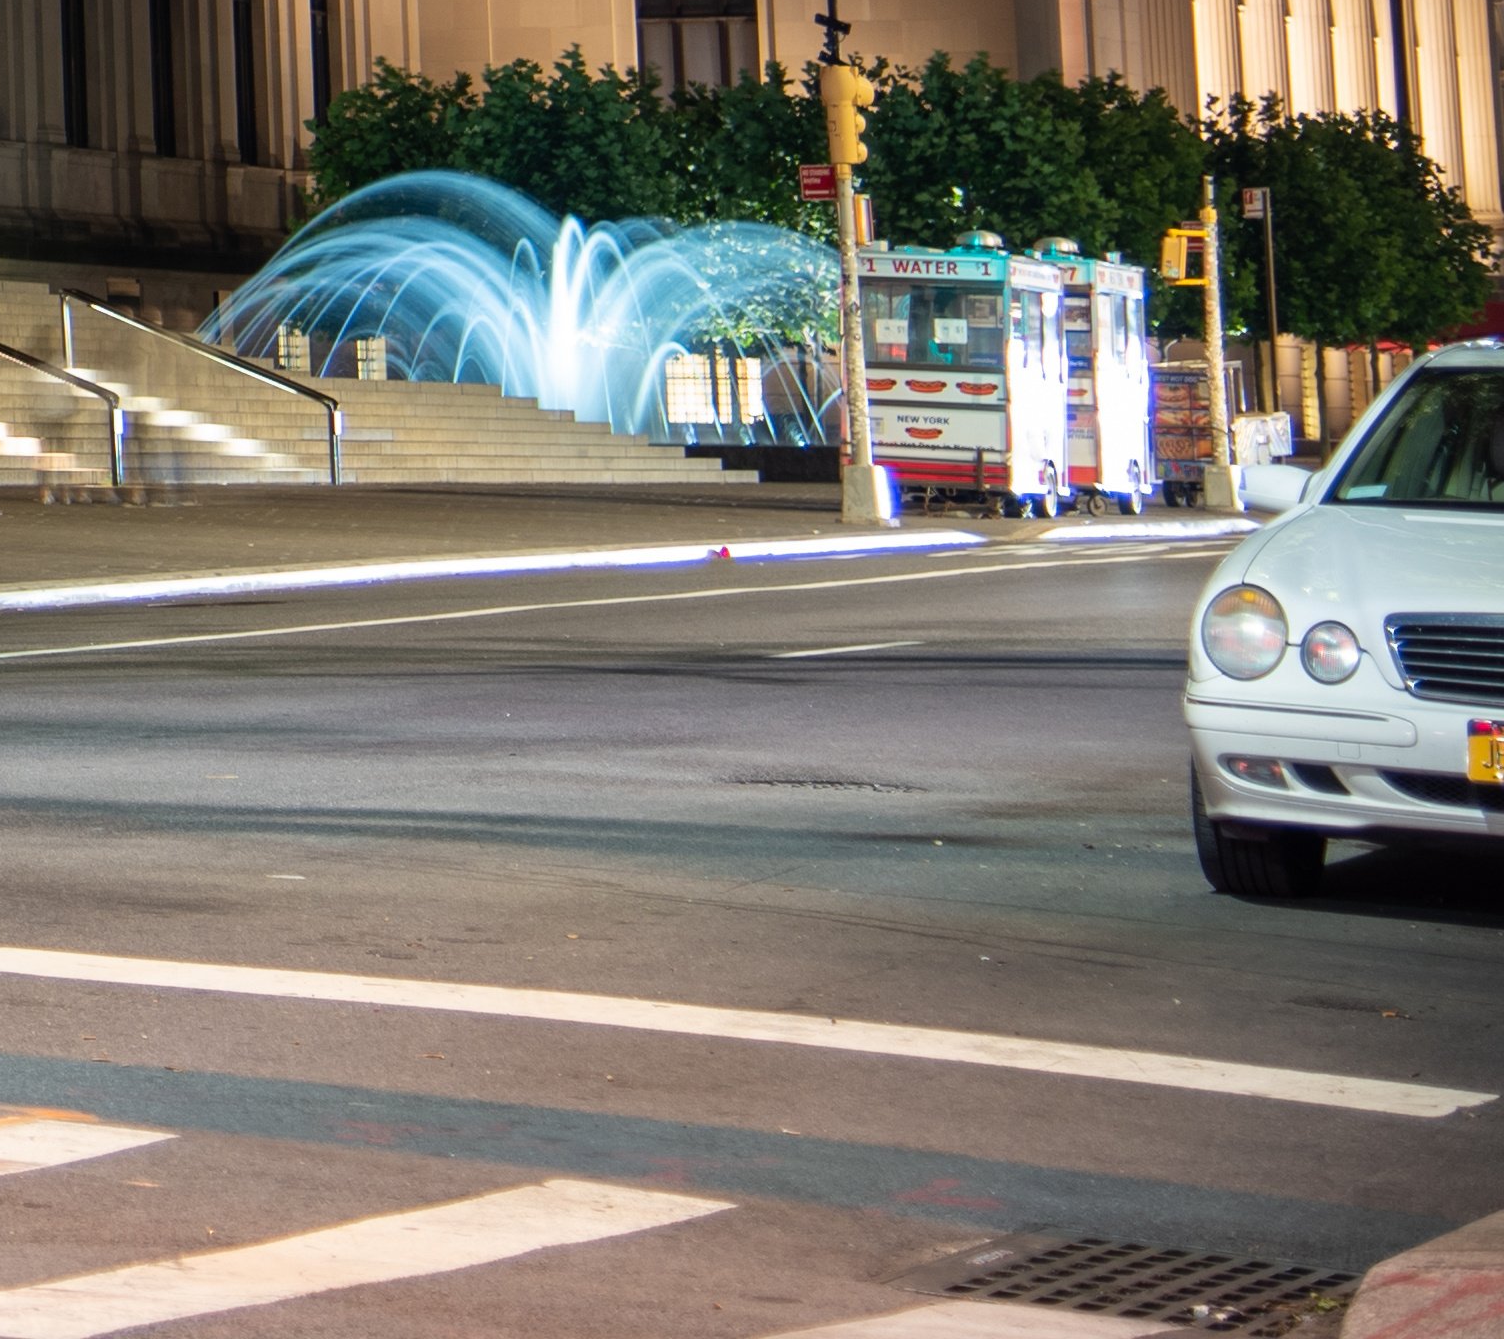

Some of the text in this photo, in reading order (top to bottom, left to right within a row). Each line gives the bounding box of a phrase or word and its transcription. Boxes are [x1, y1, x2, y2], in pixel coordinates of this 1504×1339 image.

[892, 259, 959, 275] WATER
[897, 415, 950, 425] NEW YORK
